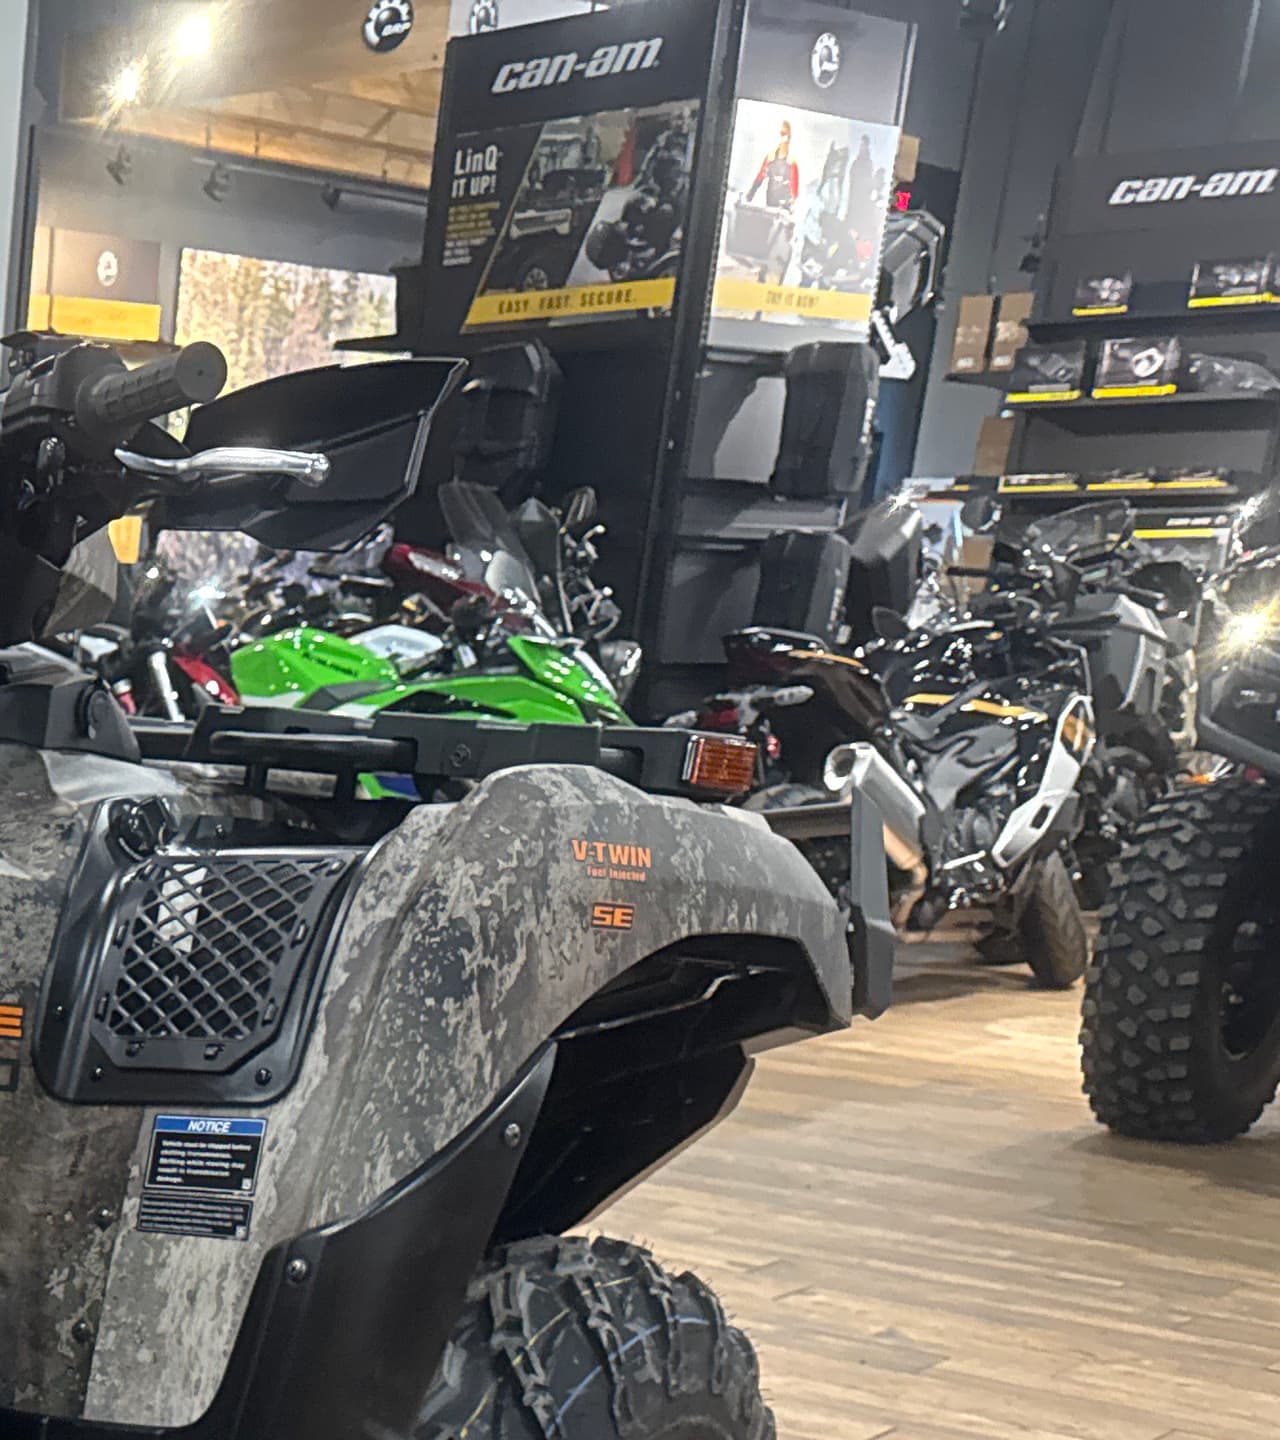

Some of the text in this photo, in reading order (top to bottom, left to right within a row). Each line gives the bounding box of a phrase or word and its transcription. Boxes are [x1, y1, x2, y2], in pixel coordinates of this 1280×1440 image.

[491, 37, 663, 94] can-am
[452, 174, 497, 198] IT UP!
[1108, 167, 1278, 205] can-am
[571, 839, 652, 869] V-TWIN
[592, 903, 634, 929] SE
[187, 1120, 232, 1133] NOTICE
